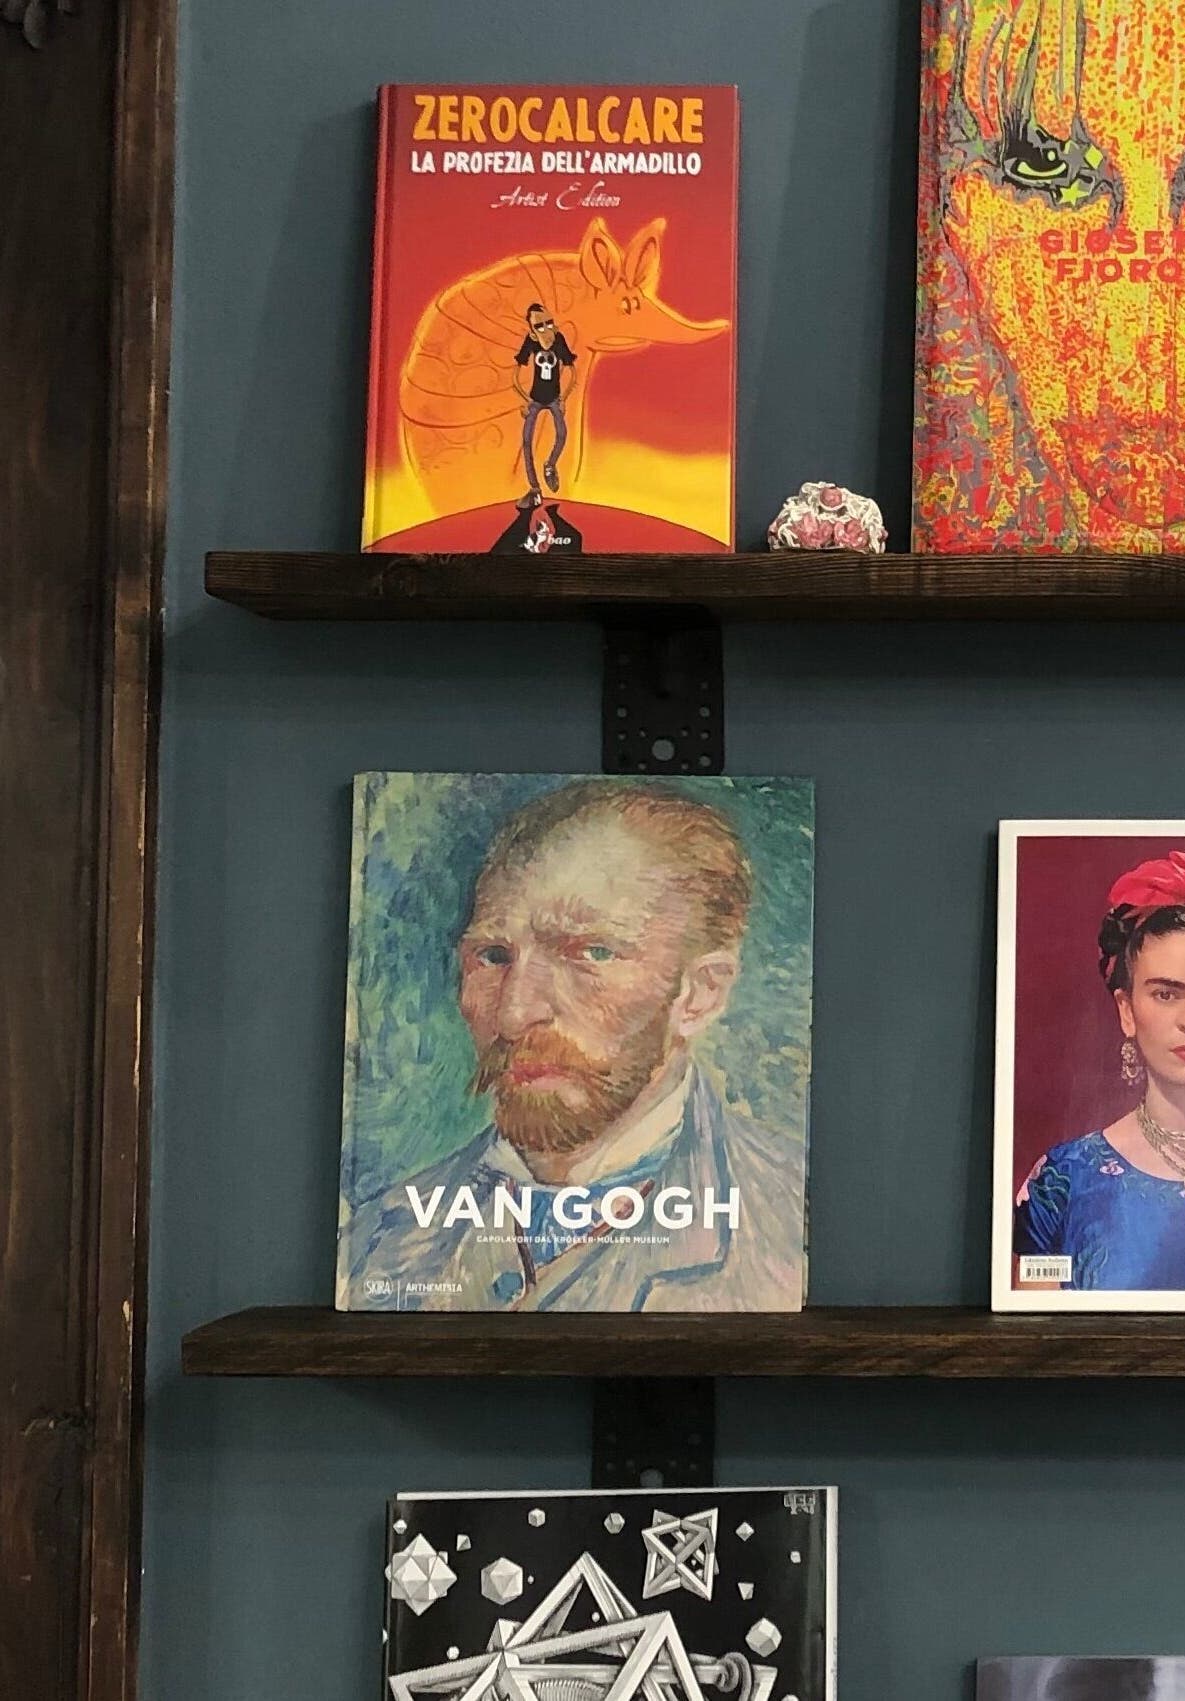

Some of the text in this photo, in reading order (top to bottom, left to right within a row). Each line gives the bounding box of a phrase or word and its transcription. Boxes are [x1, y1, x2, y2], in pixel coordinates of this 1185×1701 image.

[413, 95, 704, 145] ZEROCALCARE
[411, 150, 702, 175] LA PROFEZIA DELL'ARMADILLO
[405, 1185, 740, 1230] VAN GOGH
[476, 1234, 533, 1244] CAPOLAVORI
[535, 1234, 552, 1244] DAL
[633, 1234, 670, 1244] MUSEUM
[366, 1280, 392, 1295] SKIRA
[406, 1282, 463, 1293] ARTHEMISIA
